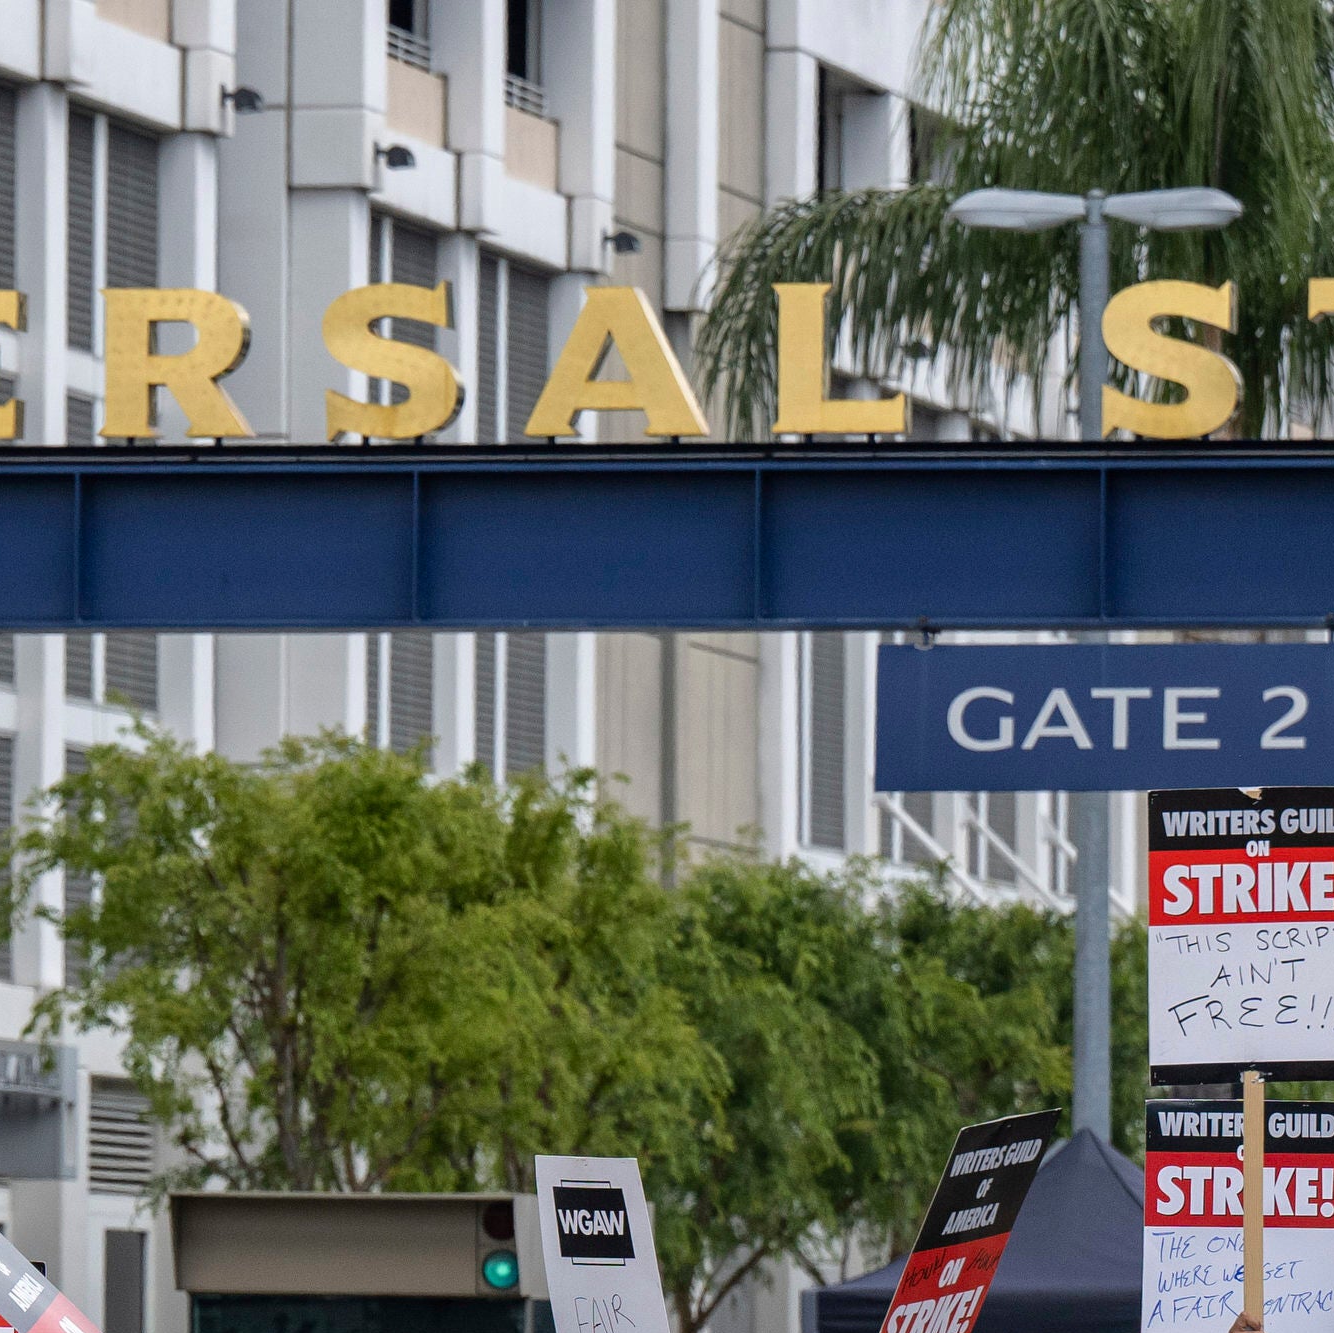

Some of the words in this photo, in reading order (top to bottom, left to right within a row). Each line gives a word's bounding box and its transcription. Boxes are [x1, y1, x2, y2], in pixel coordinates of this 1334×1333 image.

[947, 686, 1221, 752] GATE
[1260, 685, 1310, 750] 2
[1162, 809, 1276, 837] WRITERS
[1245, 840, 1270, 858] ON
[1210, 958, 1305, 988] AIN'T
[1157, 1111, 1244, 1137] WRITER
[950, 1144, 1006, 1178] WRITERS
[1003, 1138, 1043, 1167] GUILD
[976, 1178, 994, 1200] OF
[1156, 1165, 1334, 1218] STRKE!
[557, 1208, 625, 1236] WGAW
[941, 1202, 1000, 1236] AMERICA
[1152, 1231, 1196, 1262] THE
[938, 1256, 967, 1288] ON
[1157, 1264, 1216, 1293] WHERE
[1147, 1299, 1165, 1329] A
[1173, 1290, 1240, 1323] FAIR
